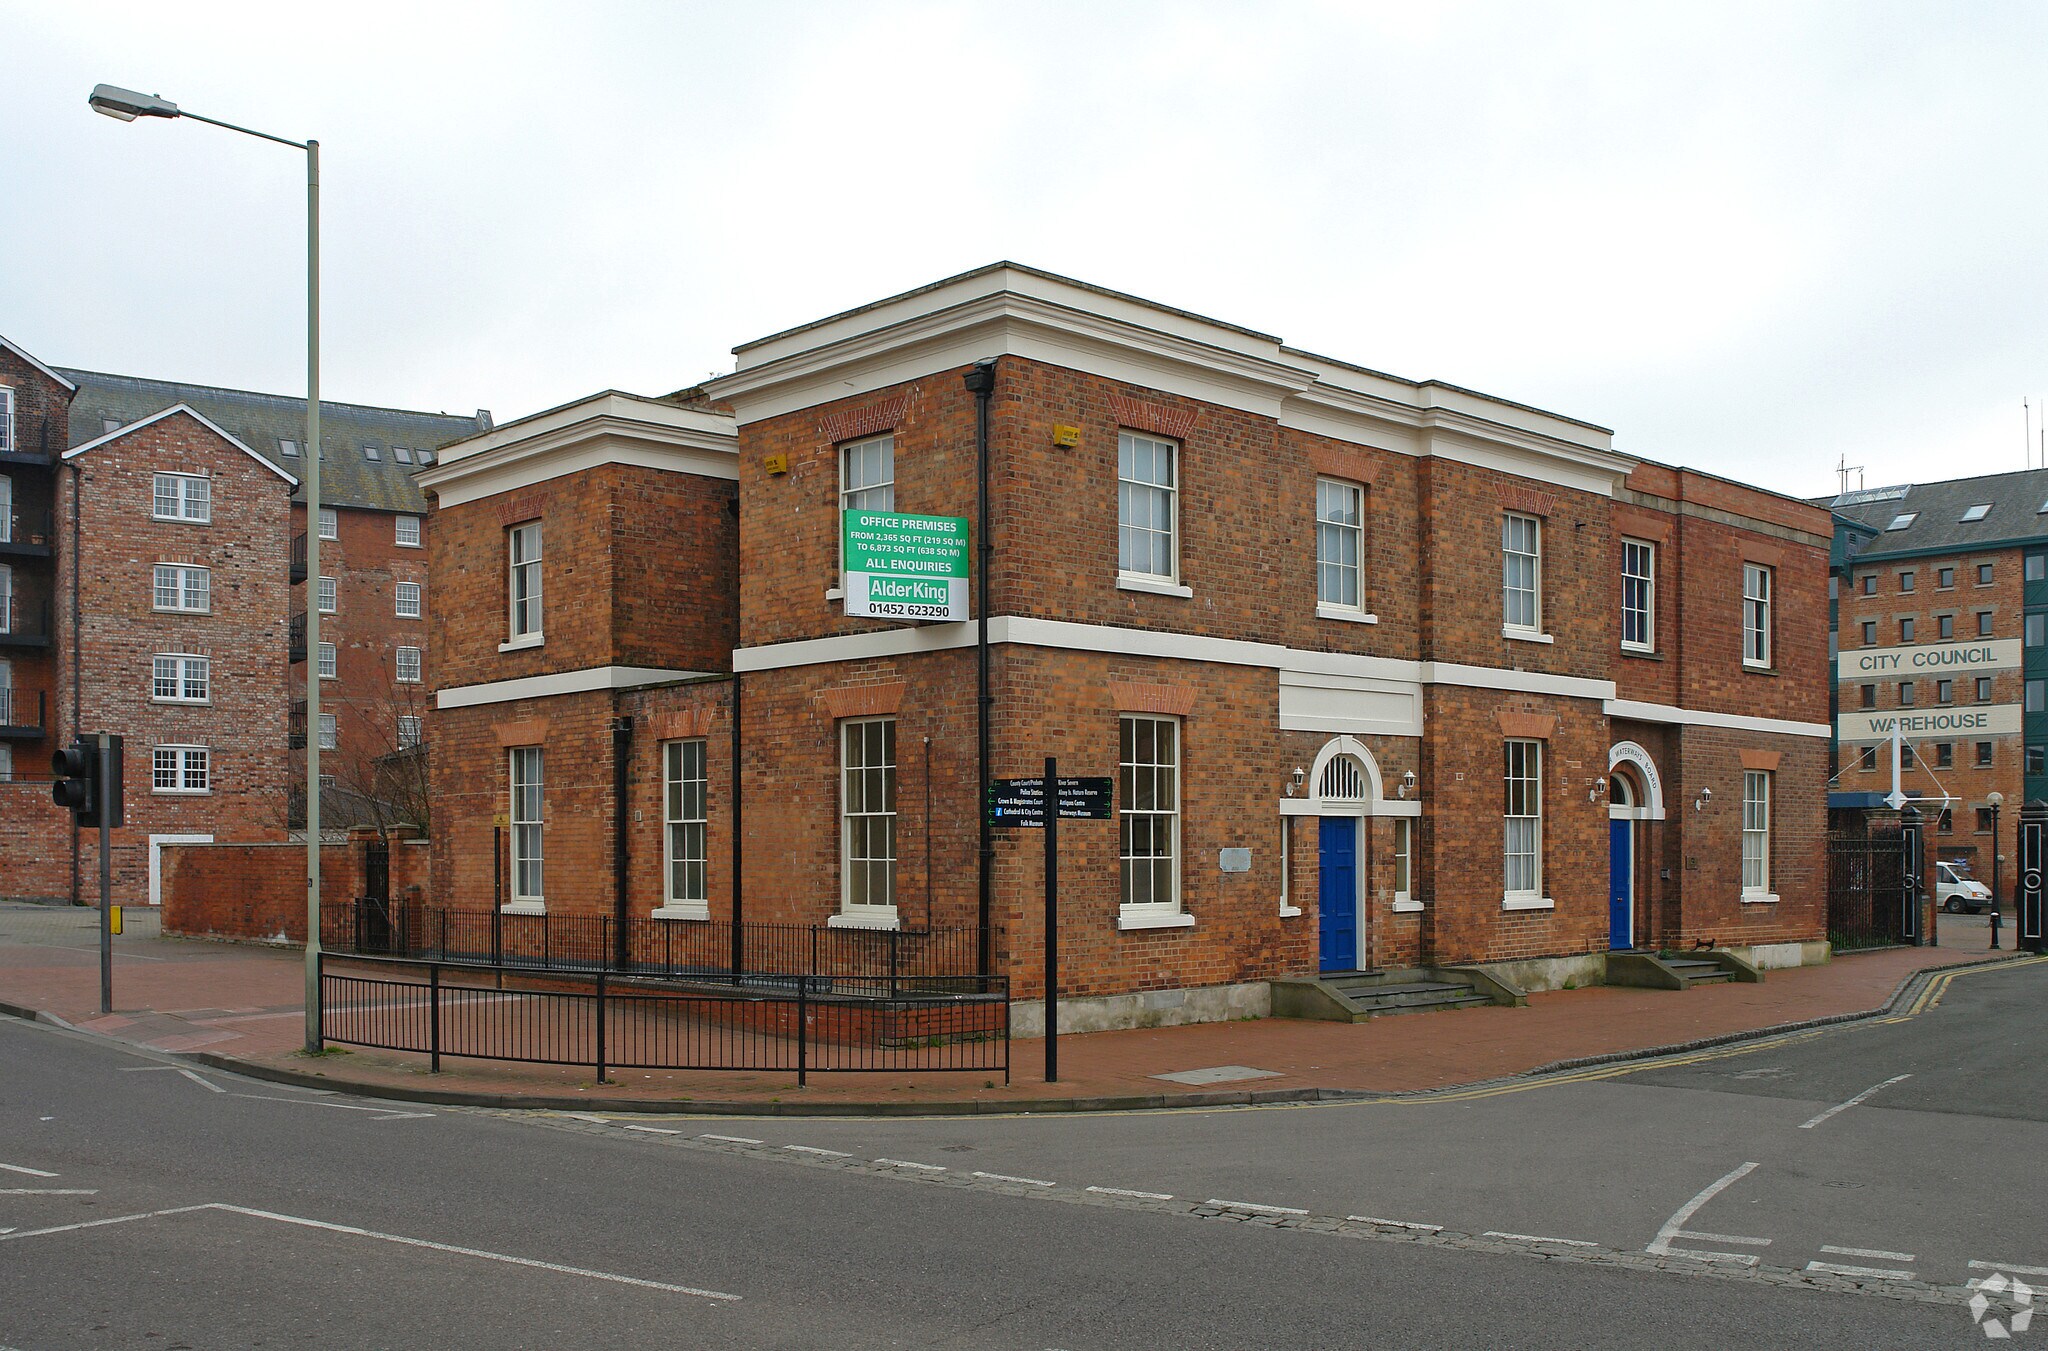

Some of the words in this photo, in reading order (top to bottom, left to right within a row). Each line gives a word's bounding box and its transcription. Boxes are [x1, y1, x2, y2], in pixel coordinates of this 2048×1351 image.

[860, 516, 899, 528] OFFICE
[903, 520, 956, 532] PREMISES
[851, 532, 874, 540] FROM
[876, 534, 897, 542] 2,365
[900, 535, 910, 543] SQ
[943, 538, 953, 546] SQ
[866, 558, 887, 568] ALL
[891, 560, 952, 572] ENQUIRIES
[870, 603, 904, 614] 01452
[908, 605, 949, 617] 623290
[1860, 654, 1901, 670] CITY
[1913, 648, 1997, 666] COUNCIL
[1869, 713, 1987, 732] WAREHOUSE
[1615, 748, 1642, 760] WATERWAYS
[1645, 762, 1656, 788] BOARD
